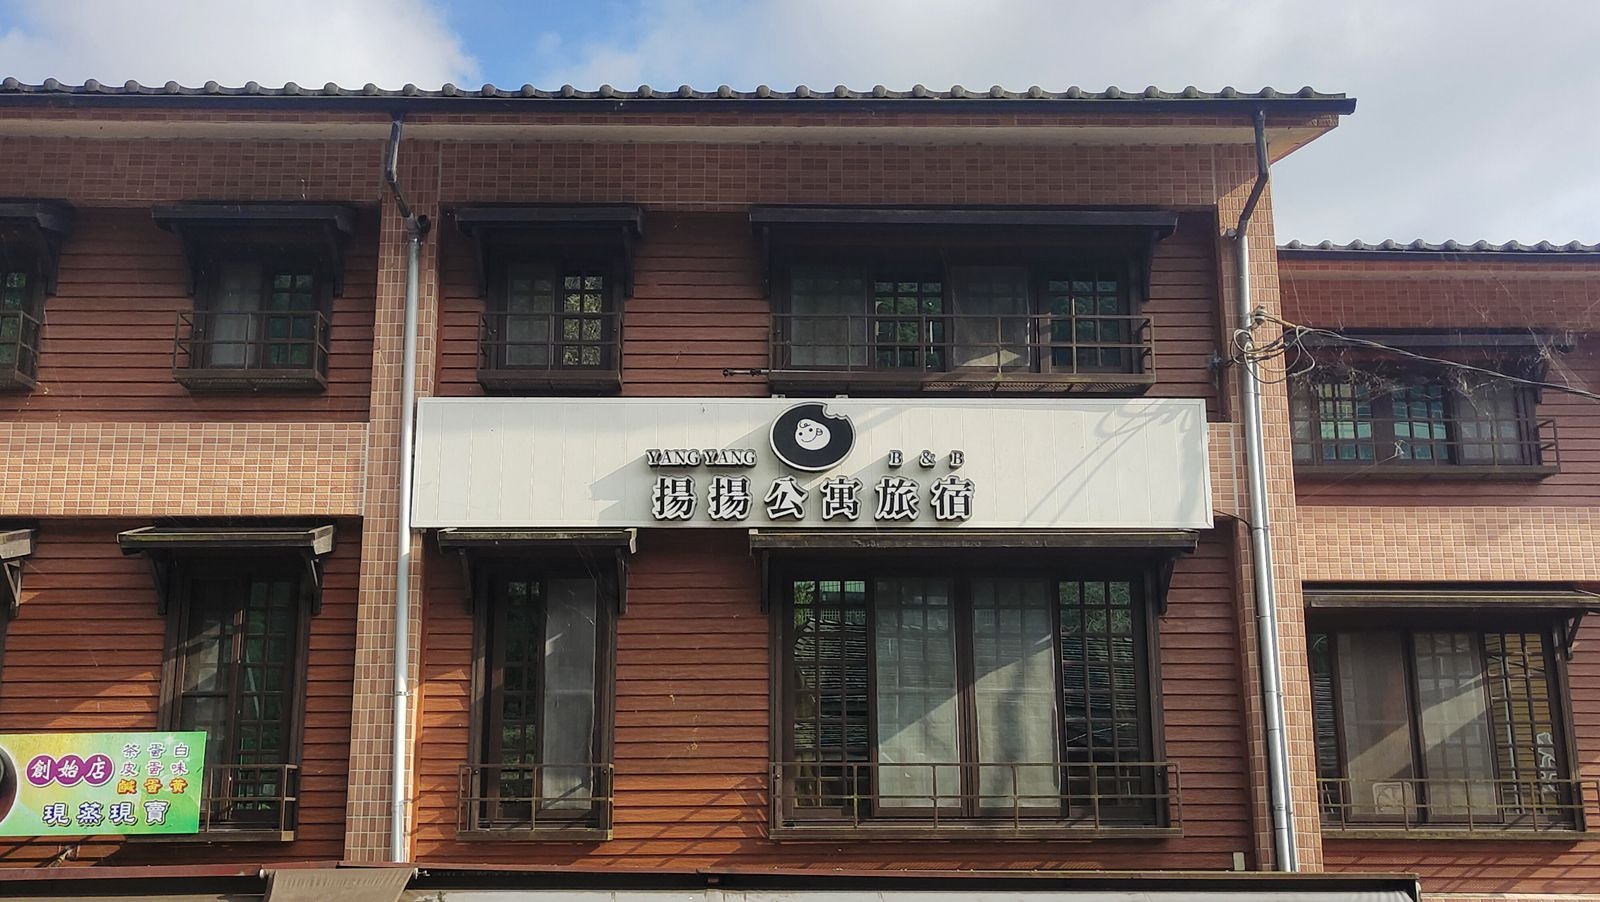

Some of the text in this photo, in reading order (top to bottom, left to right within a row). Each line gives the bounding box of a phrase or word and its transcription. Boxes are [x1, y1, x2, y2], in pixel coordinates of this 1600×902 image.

[646, 449, 965, 467] YANG YANG B & B
[653, 475, 975, 520] 揚揚公寓旅宿
[30, 757, 107, 780] 創始店
[120, 761, 189, 777] 皮蛋味
[42, 801, 170, 826] 現蒸現賣
